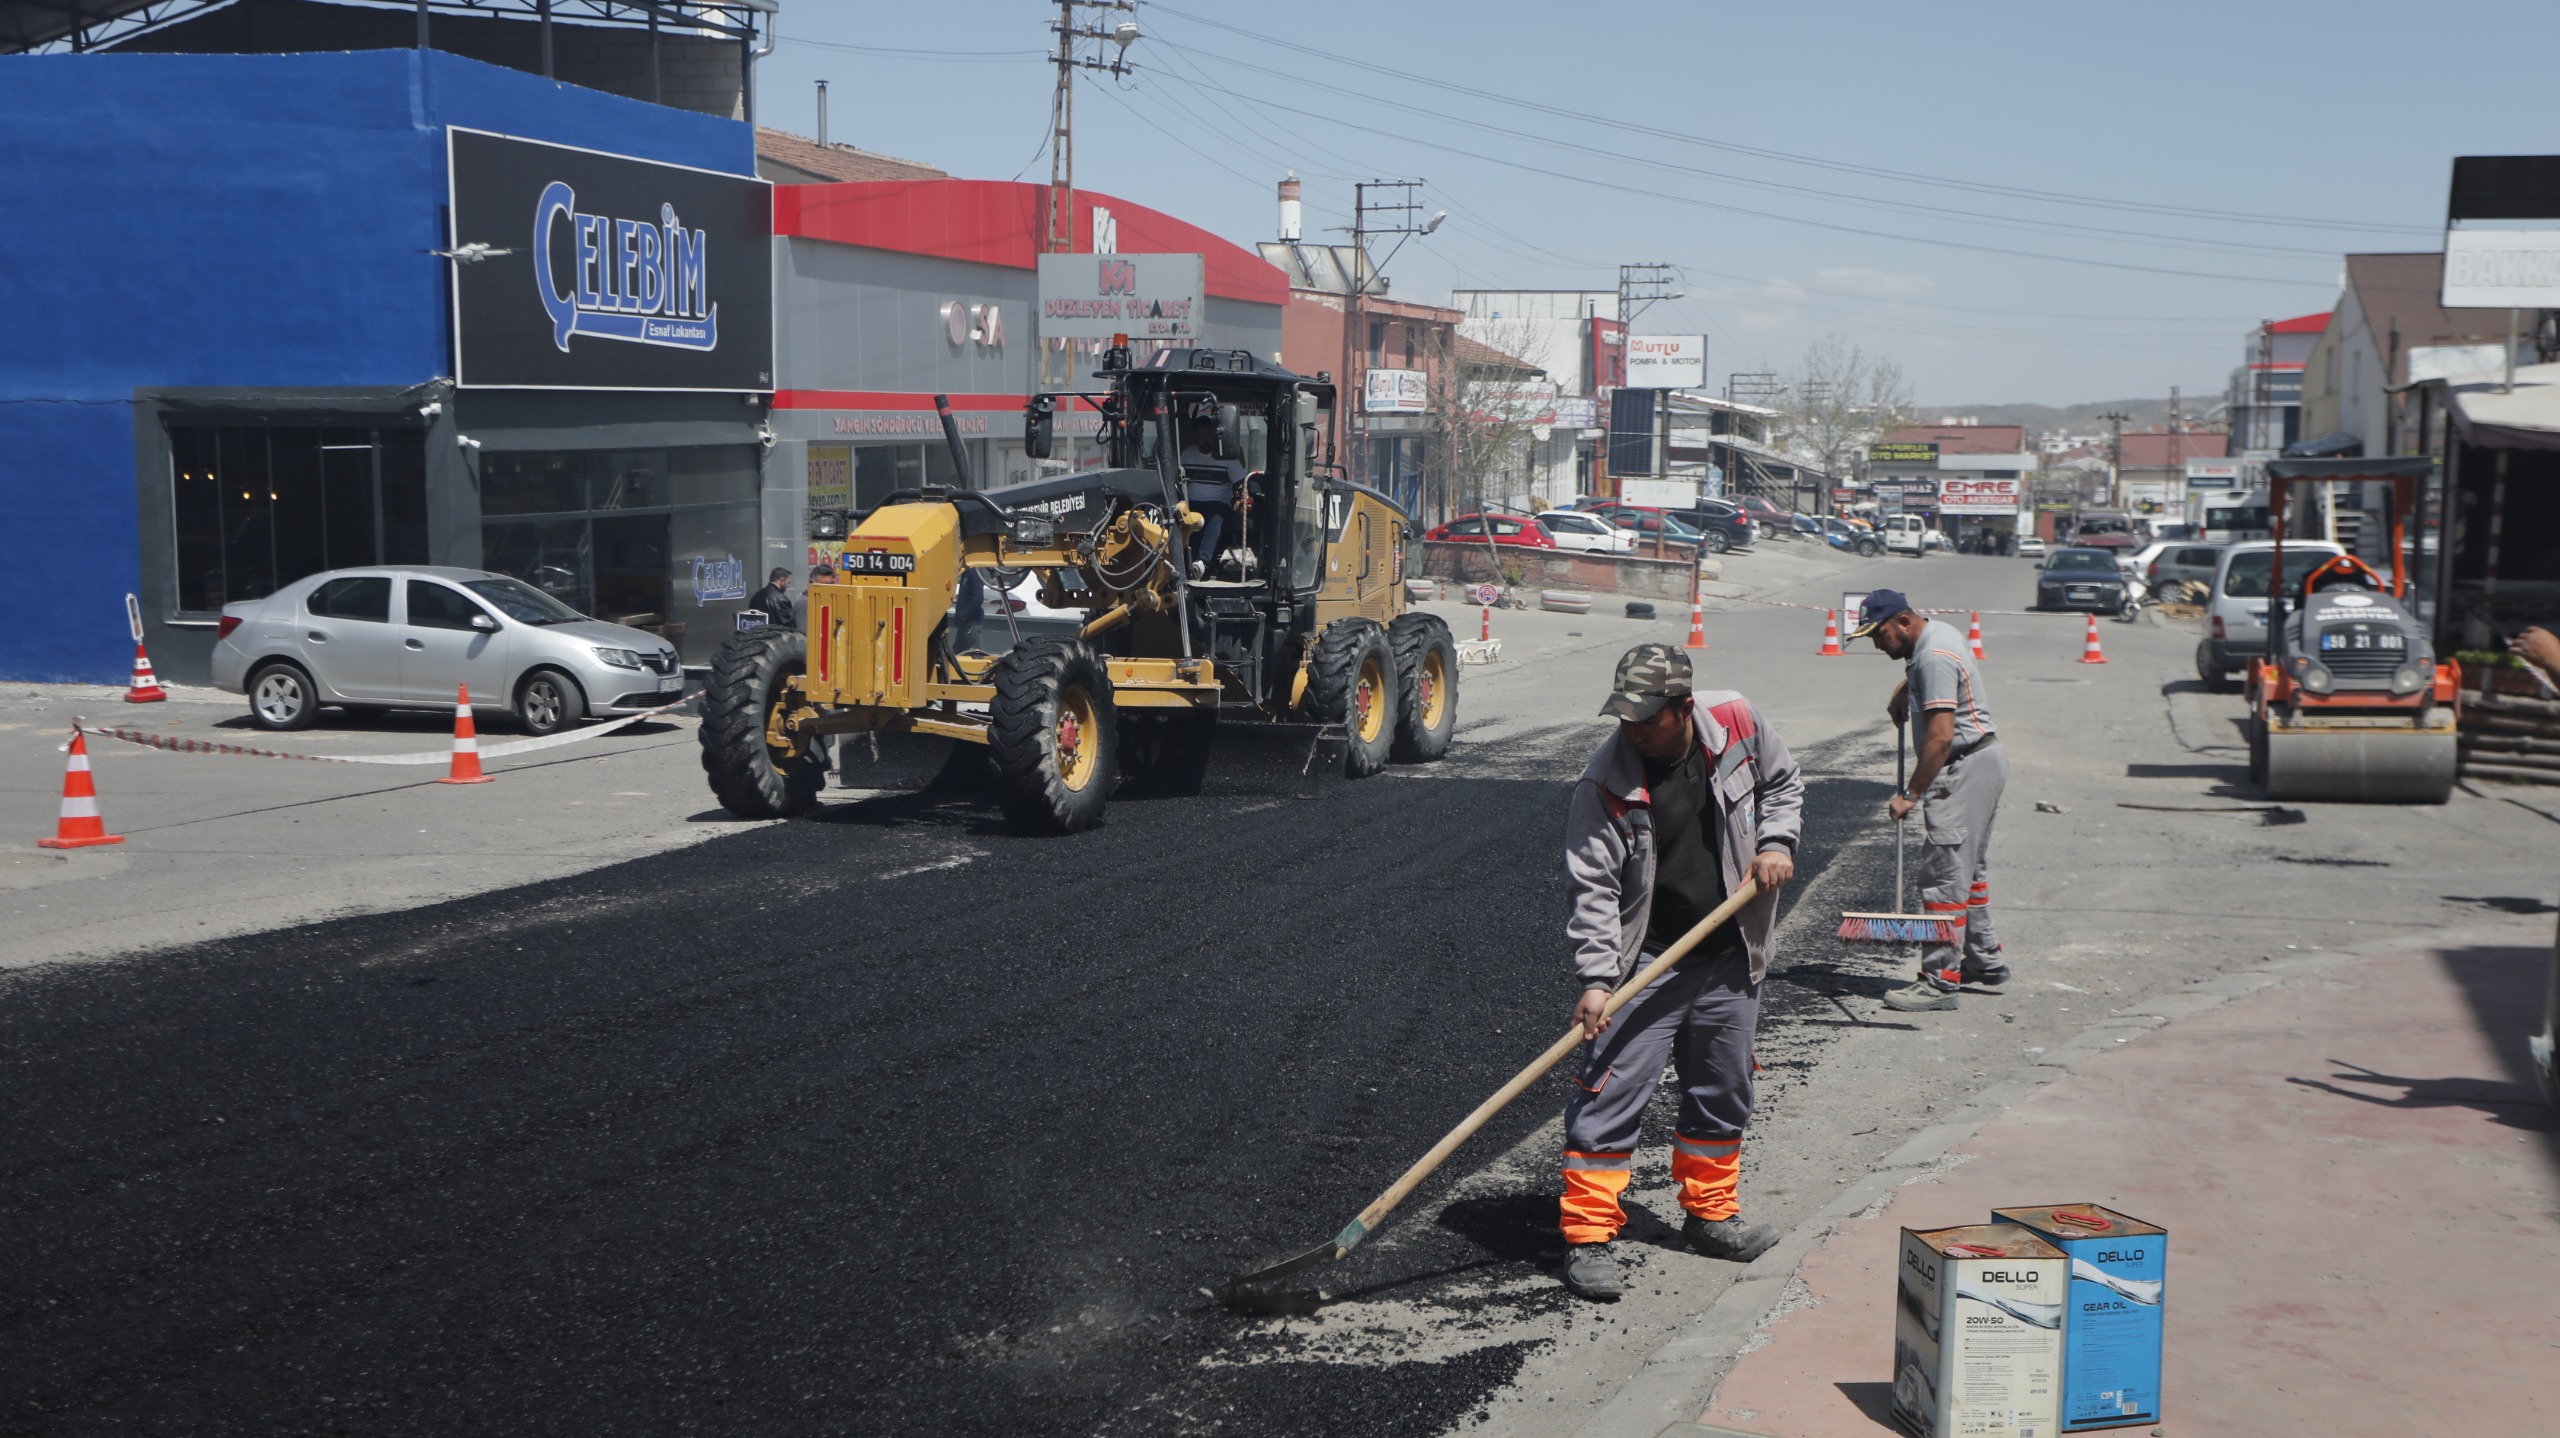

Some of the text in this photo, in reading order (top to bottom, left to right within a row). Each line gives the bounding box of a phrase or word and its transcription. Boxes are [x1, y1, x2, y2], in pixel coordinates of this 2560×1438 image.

[1045, 296, 1191, 319] DÜZLEYEN TİCARET
[649, 323, 706, 339] Esnaf Lokantası
[1149, 322, 1170, 334] LTD.
[1630, 340, 1680, 356] MUTLU
[1630, 357, 1702, 366] POMPA & MOTOR
[834, 416, 869, 433] YANGIN
[924, 417, 935, 433] VE
[1946, 482, 2014, 493] EMRE
[1050, 491, 1086, 515] BELEDİYESİ
[849, 554, 913, 570] 50 14 004
[2331, 635, 2347, 649] 50
[2354, 635, 2371, 648] 21
[2098, 1249, 2144, 1264] DELLO
[1907, 1249, 1935, 1282] DELLO
[1982, 1271, 2039, 1283] DELLO
[2083, 1301, 2127, 1312] GEAR OIL
[1966, 1316, 2004, 1324] 20W-50
